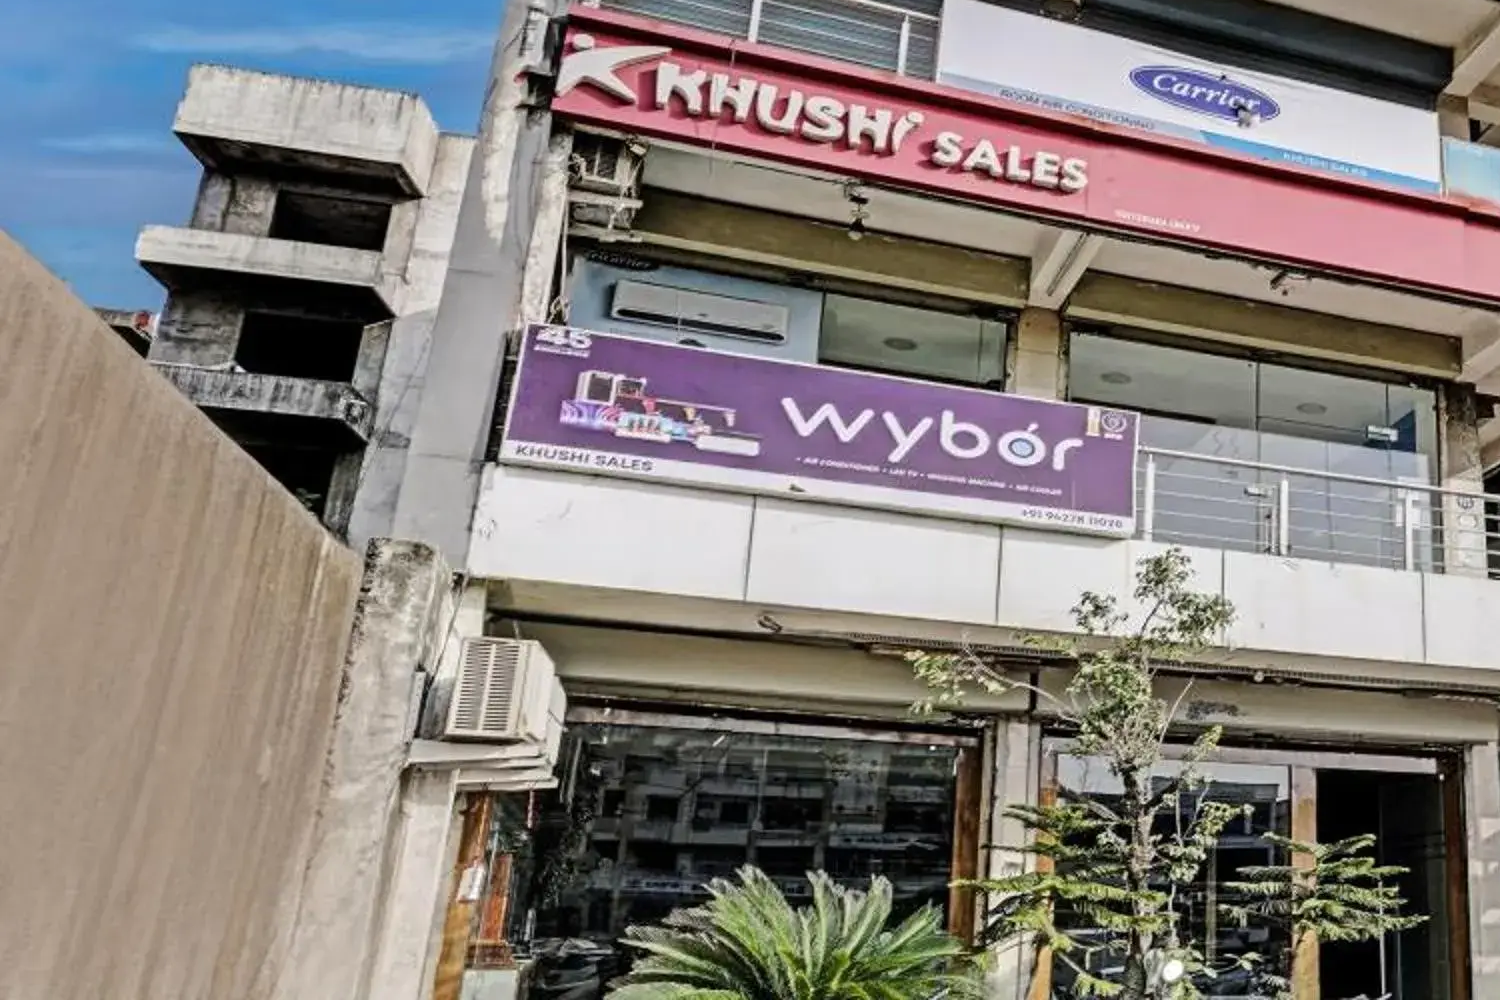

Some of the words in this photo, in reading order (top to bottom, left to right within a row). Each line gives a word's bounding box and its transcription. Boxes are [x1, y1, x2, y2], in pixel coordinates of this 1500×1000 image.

[1152, 72, 1262, 114] Carrier
[931, 130, 1089, 194] SALES
[514, 444, 591, 464] KHUSHI
[595, 454, 654, 473] SALES
